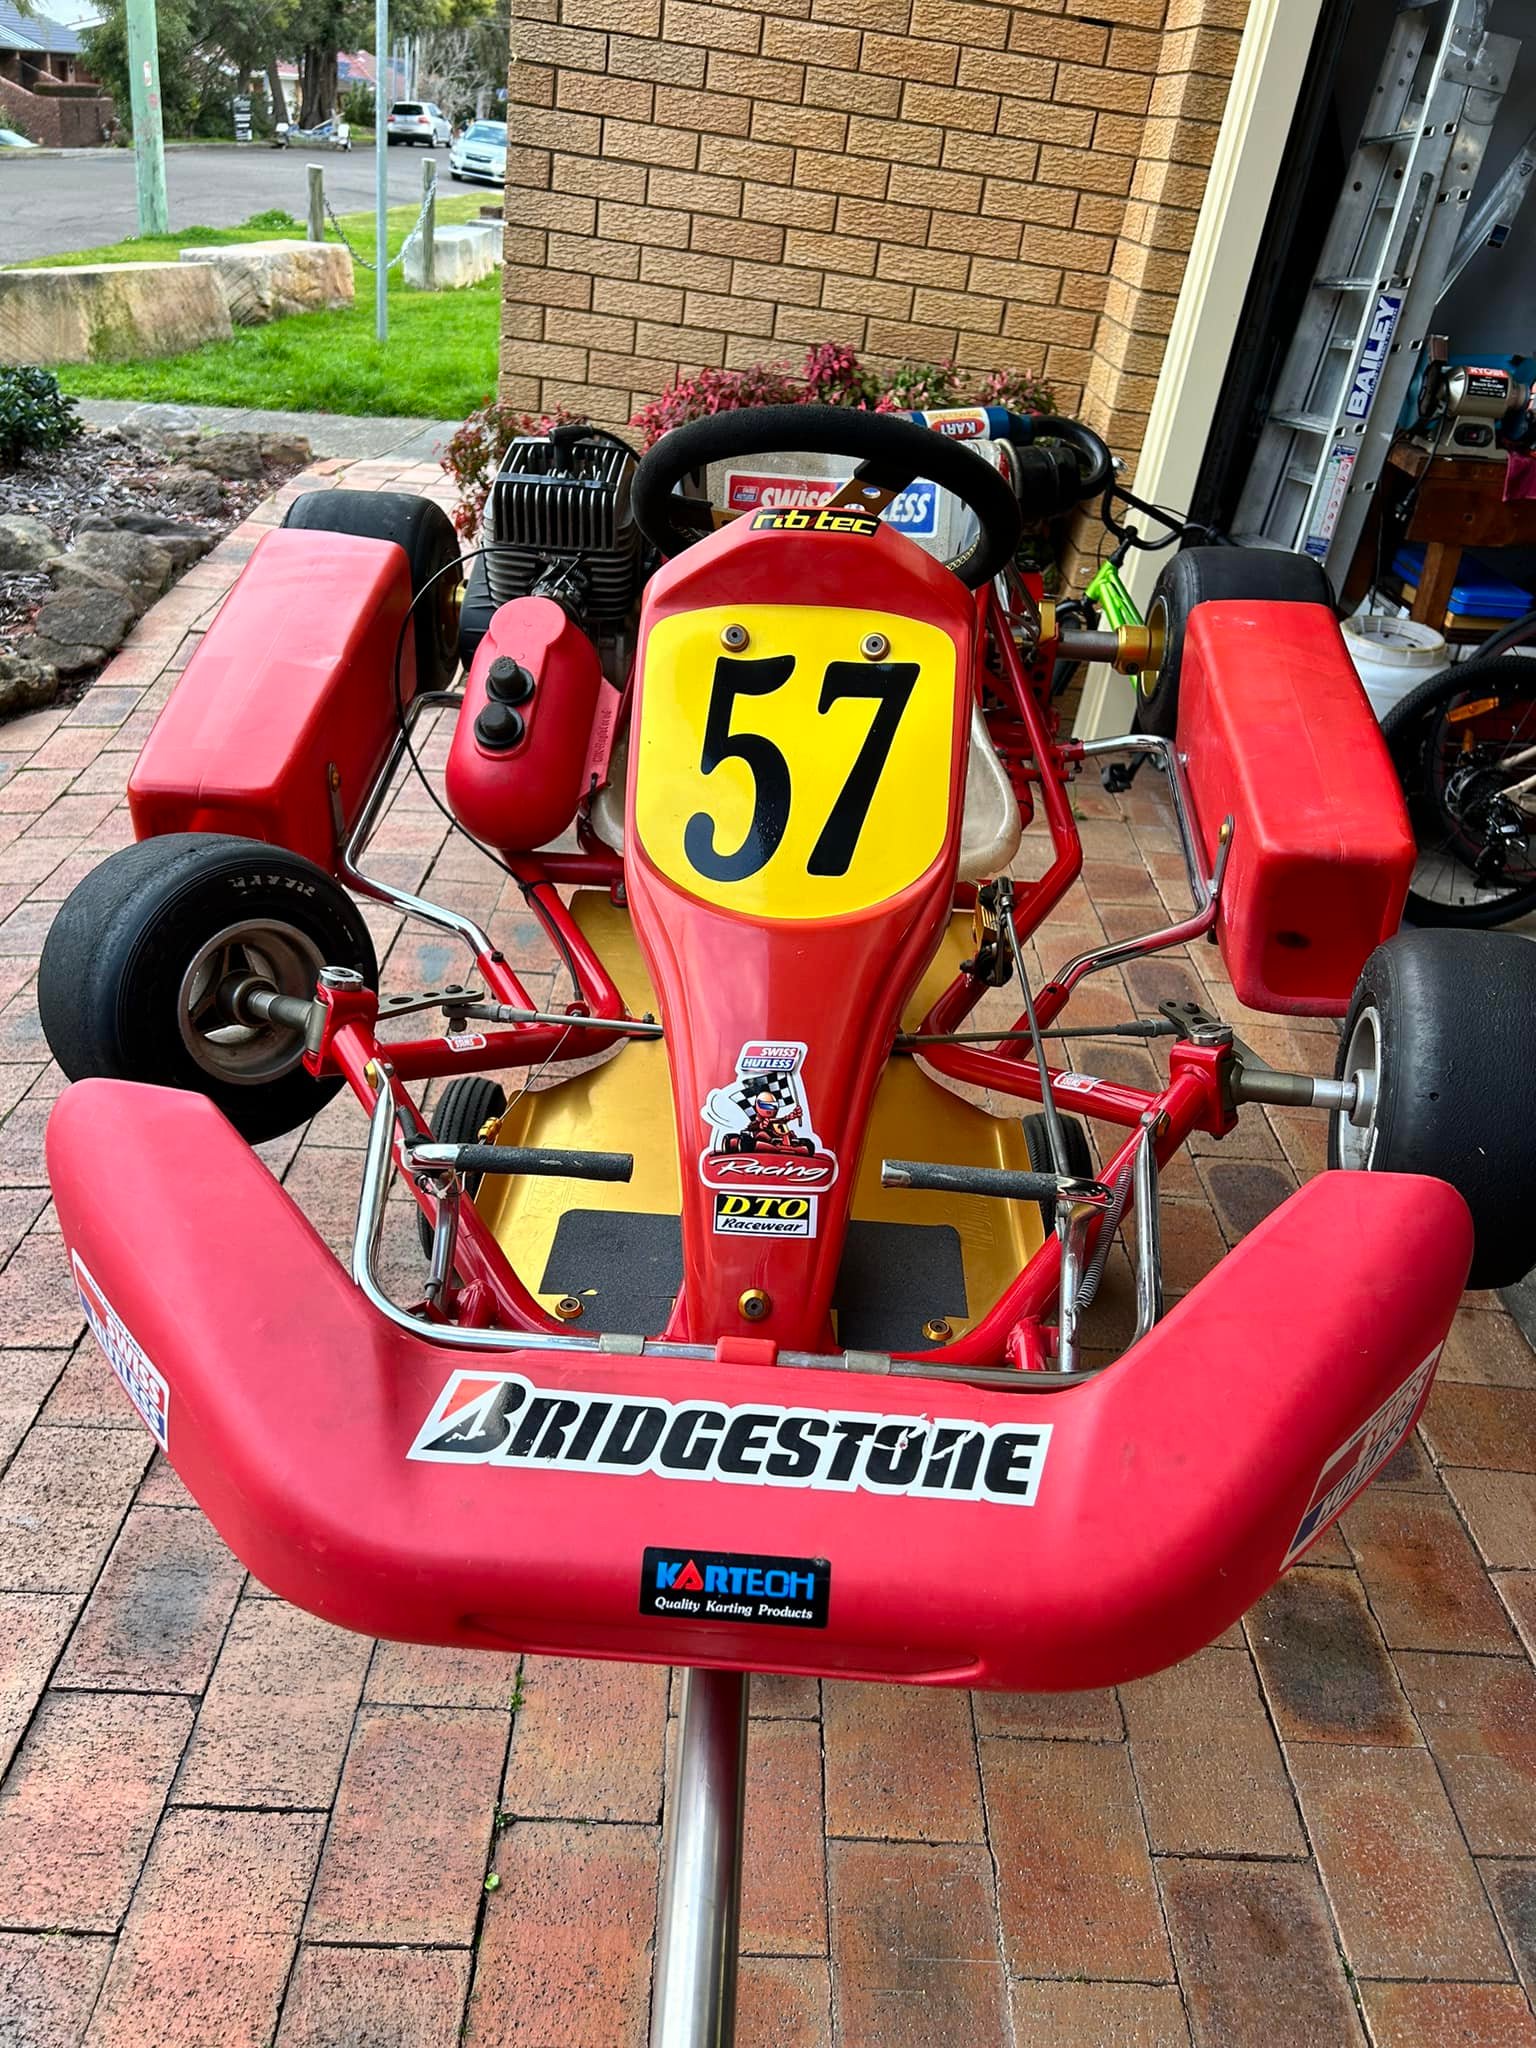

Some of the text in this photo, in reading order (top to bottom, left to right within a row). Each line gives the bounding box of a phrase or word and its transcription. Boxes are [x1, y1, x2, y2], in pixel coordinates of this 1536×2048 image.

[1350, 297, 1397, 415] BAILEY
[940, 421, 976, 435] KART
[684, 655, 920, 882] 57
[742, 1058, 793, 1069] HUTLESS
[760, 1047, 797, 1057] SWISS
[709, 1158, 830, 1182] Racing
[721, 1218, 803, 1232] Racewear
[106, 1314, 160, 1404] SWISS
[421, 1382, 1041, 1496] BRIDGESTONE
[656, 1559, 815, 1600] KARTECH
[655, 1596, 813, 1619] Quality Karting Products
